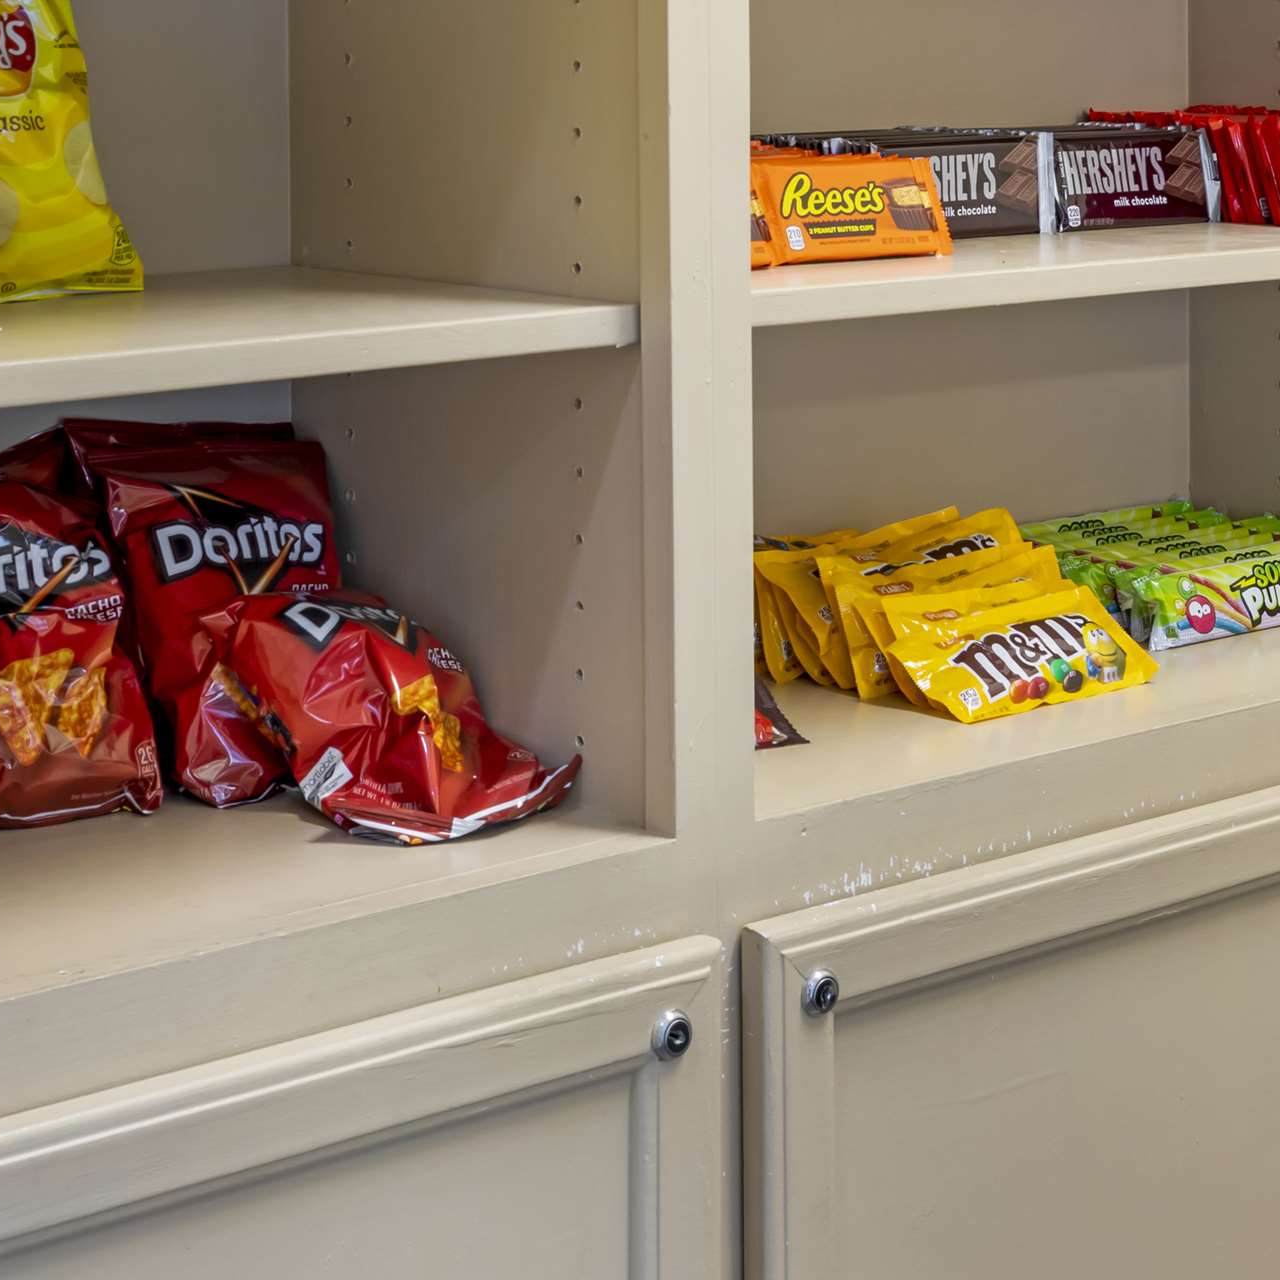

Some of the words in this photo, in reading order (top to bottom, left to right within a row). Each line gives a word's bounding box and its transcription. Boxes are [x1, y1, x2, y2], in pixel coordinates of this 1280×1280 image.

[1063, 146, 1166, 195] HERSHEY'S
[957, 205, 997, 217] chocolate
[1114, 196, 1130, 207] milk
[1131, 195, 1167, 206] chocolate
[156, 516, 323, 576] Doritos
